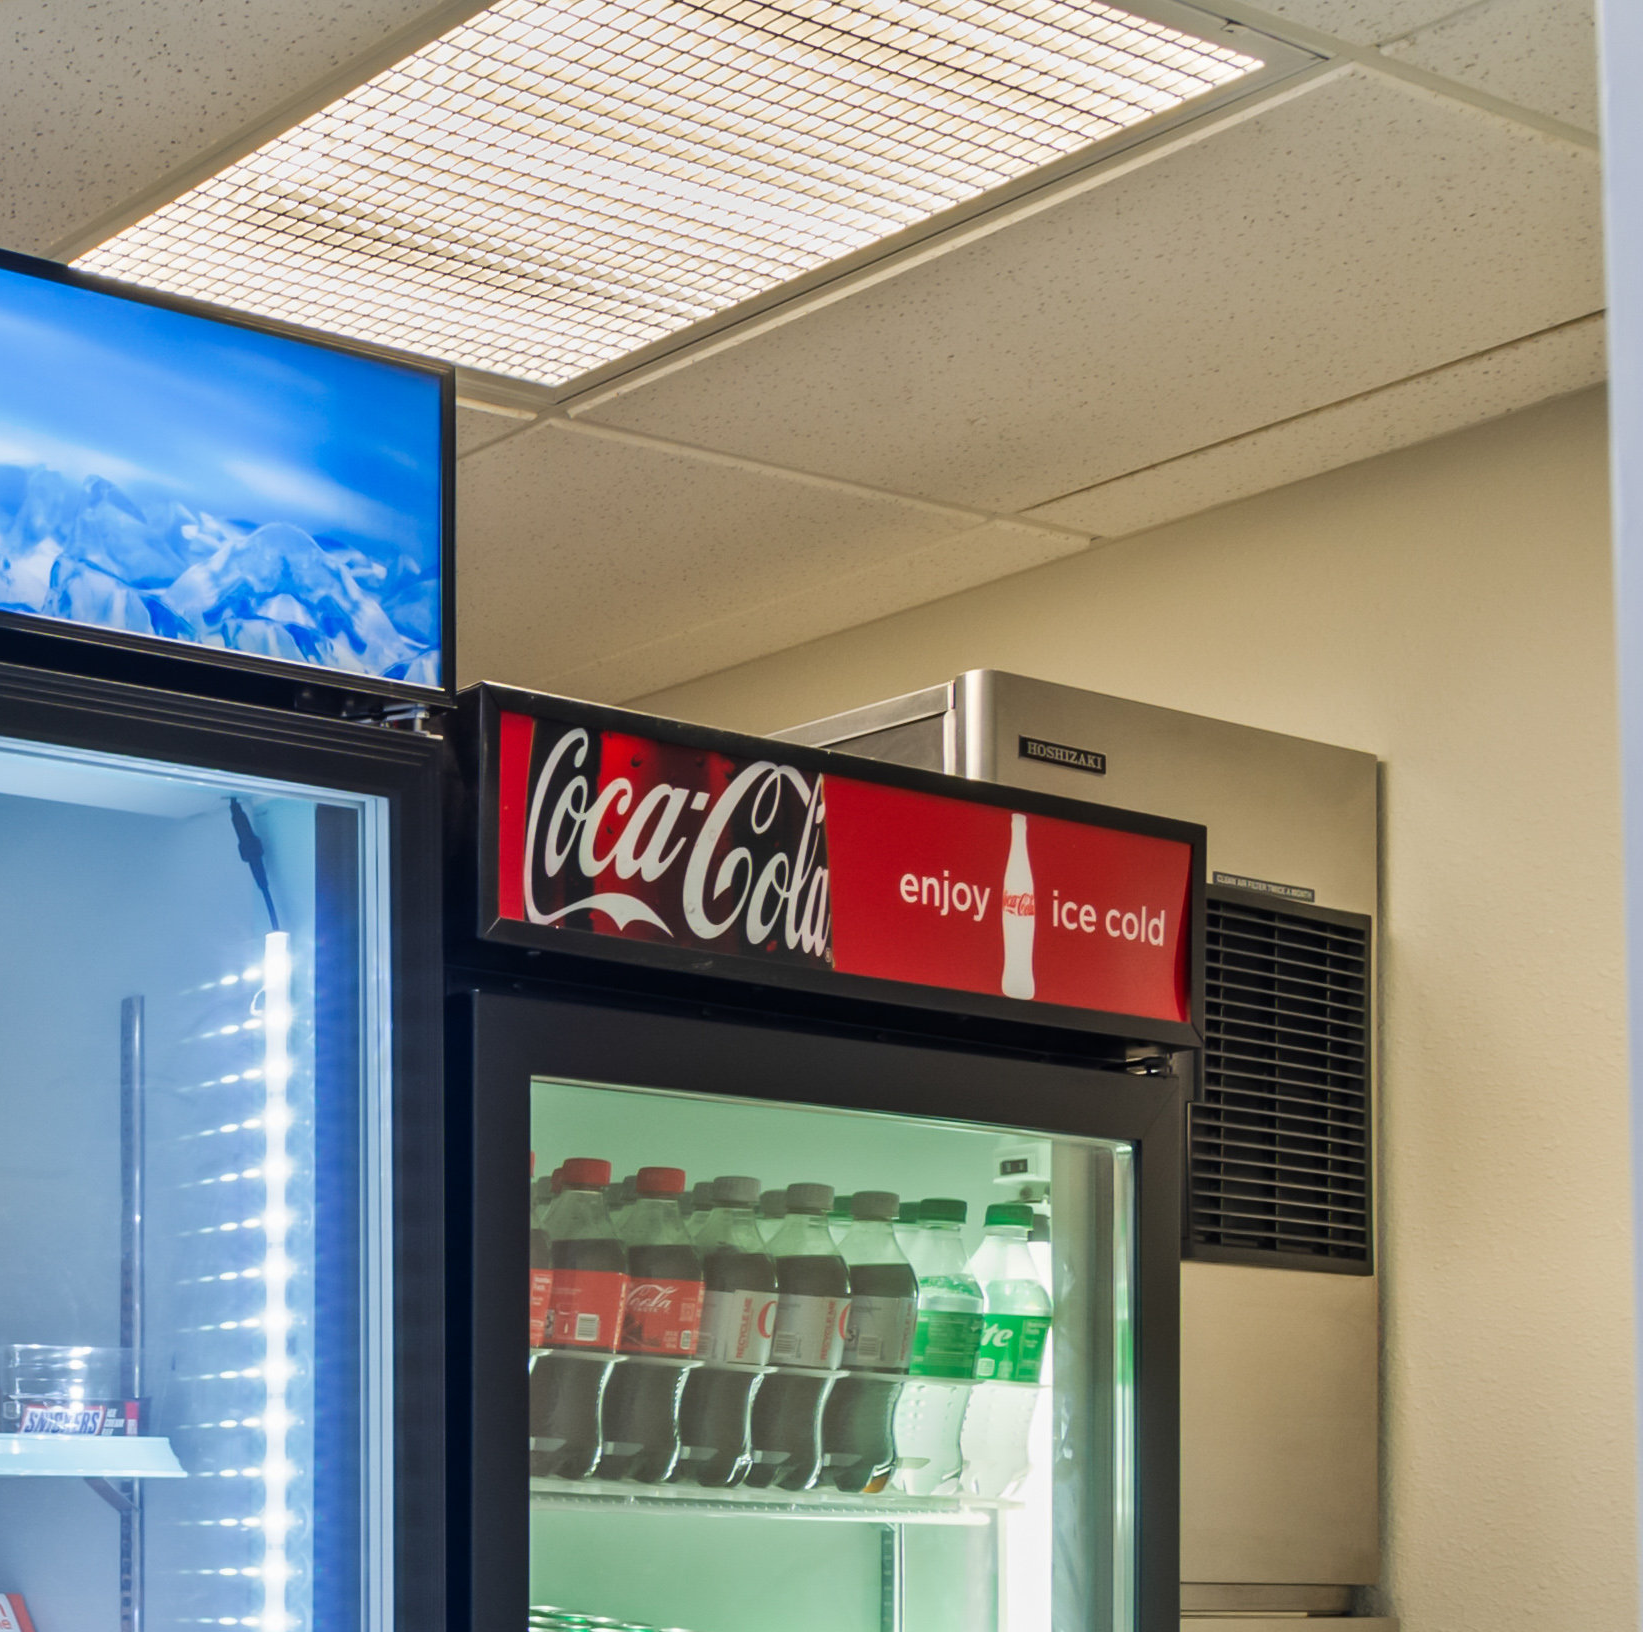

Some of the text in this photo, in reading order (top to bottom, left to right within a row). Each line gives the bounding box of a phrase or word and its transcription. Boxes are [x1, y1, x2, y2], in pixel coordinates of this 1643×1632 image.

[1027, 741, 1103, 770] HOSHIZAKI
[523, 727, 832, 961] Coca-Cola
[900, 872, 1166, 946] enjoy ice cold
